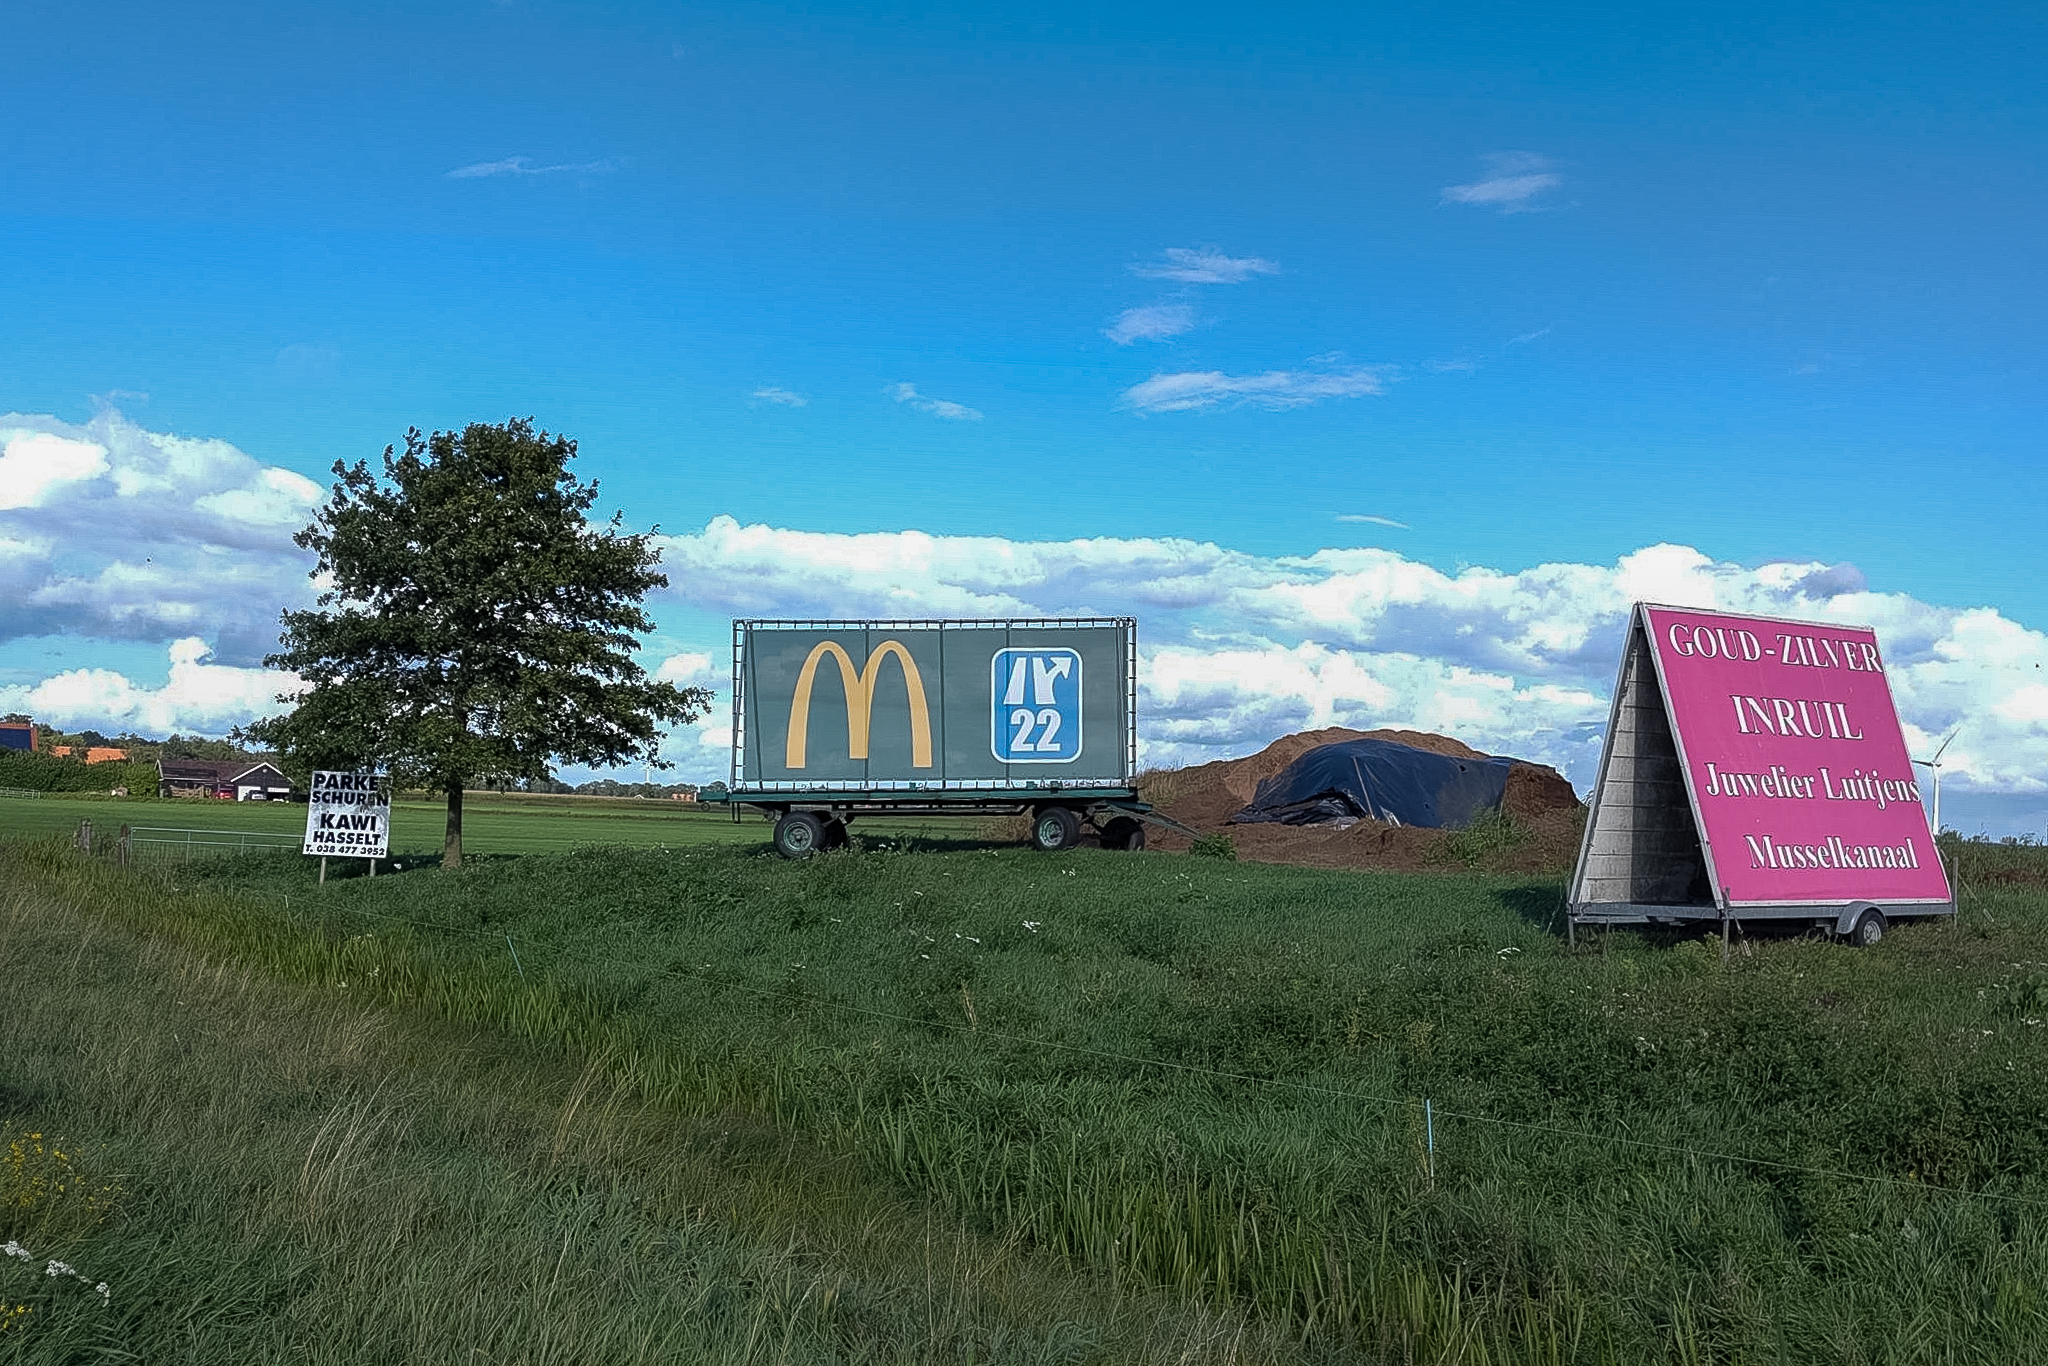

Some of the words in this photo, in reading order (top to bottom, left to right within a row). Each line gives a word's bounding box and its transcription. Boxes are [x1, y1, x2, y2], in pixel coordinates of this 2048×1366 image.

[1668, 623, 1883, 673] GOUD-ZILVER
[1008, 708, 1062, 752] 22
[1731, 694, 1863, 740] INRUIL
[313, 773, 388, 791] PARKE
[1705, 762, 1815, 799] Juwelier
[1818, 767, 1921, 810] Luitjens
[312, 831, 381, 846] HASSELT
[320, 813, 377, 832] KAWI
[305, 844, 313, 852] T.
[316, 845, 335, 853] 038
[338, 846, 358, 854] 477
[360, 847, 385, 856] 3952
[1744, 834, 1919, 870] Musselkanaal
